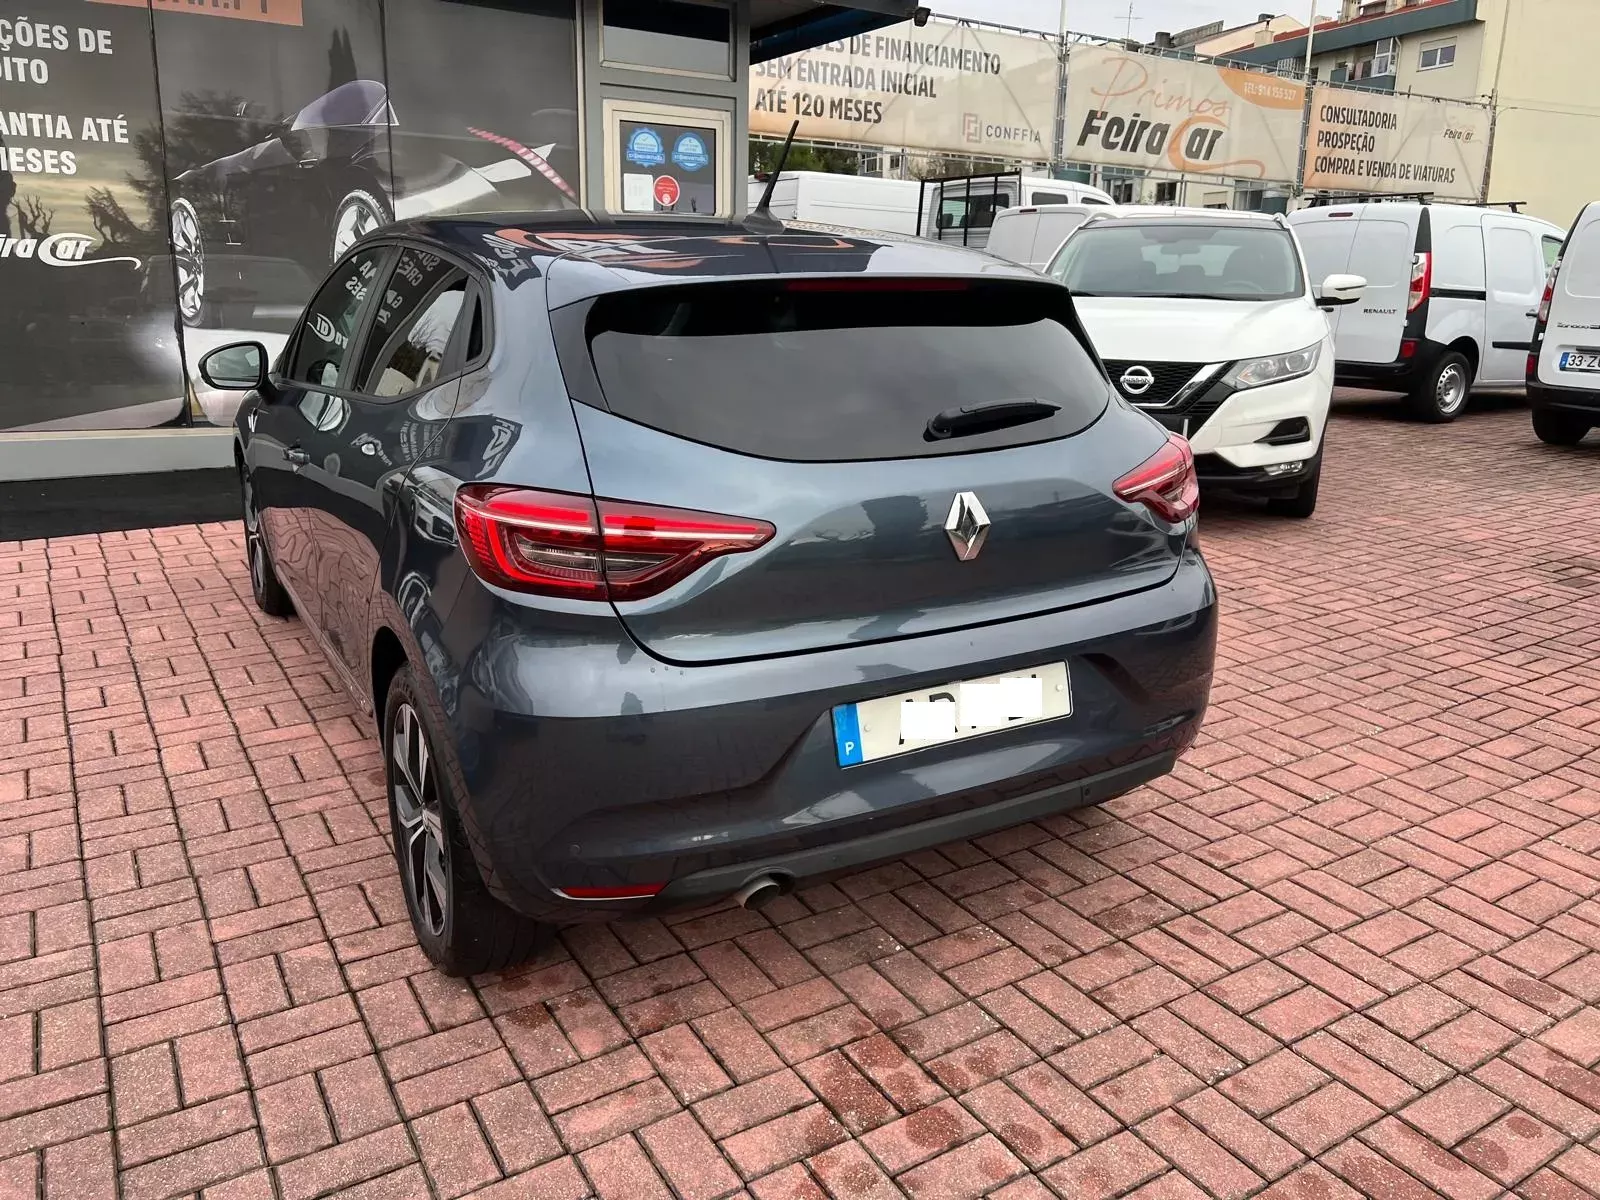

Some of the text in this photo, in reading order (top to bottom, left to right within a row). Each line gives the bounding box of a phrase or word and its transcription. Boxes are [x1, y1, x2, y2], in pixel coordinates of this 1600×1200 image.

[78, 27, 113, 55] DE
[850, 33, 871, 58] DE
[875, 36, 1001, 75] FINANCIAMENTO
[0, 56, 49, 85] ITO
[755, 56, 937, 98] SEM ENTRADA INICIAL
[1091, 57, 1232, 118] Primos
[755, 86, 882, 124] ATÉ 120 MESES
[1320, 105, 1397, 130] CONSULTADORIA
[82, 114, 129, 144] ATÉ
[986, 125, 1041, 143] CONFFIA
[1317, 130, 1375, 155] PROSPEÇÃO
[1314, 156, 1455, 184] COMPRA E VENDA DE VIATURAS
[844, 741, 855, 757] P
